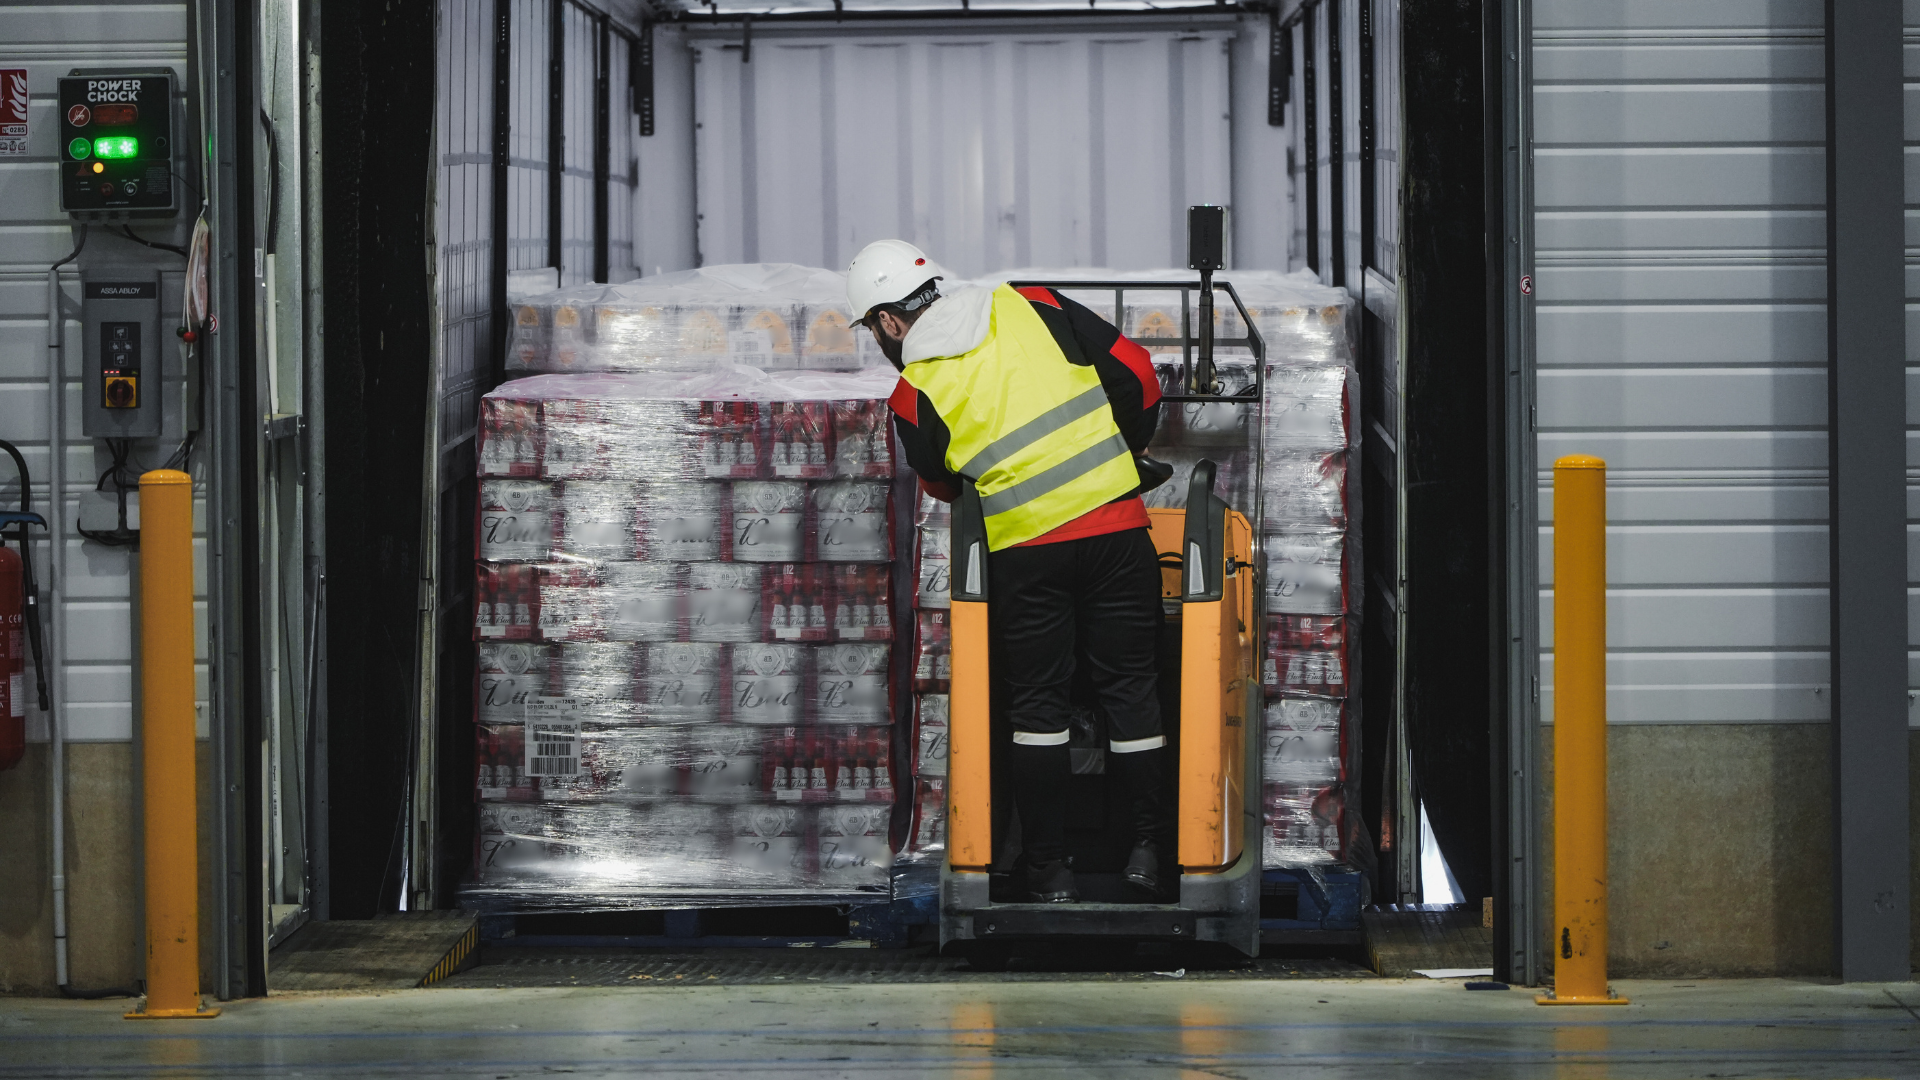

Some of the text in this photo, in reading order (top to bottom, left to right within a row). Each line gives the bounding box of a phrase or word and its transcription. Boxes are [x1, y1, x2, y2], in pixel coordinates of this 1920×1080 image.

[88, 80, 141, 91] POWER
[87, 91, 138, 102] CHOCK
[788, 486, 795, 496] 12
[787, 565, 794, 574] 12
[849, 565, 857, 574] 12
[935, 613, 943, 623] 12
[1304, 618, 1312, 628] 12
[788, 648, 795, 658] 12
[872, 648, 880, 658] 12
[1324, 703, 1332, 714] 12
[788, 727, 795, 736] 12
[850, 727, 857, 736] 12
[935, 780, 942, 790] 12
[788, 809, 795, 819] 12
[873, 809, 880, 819] 12
